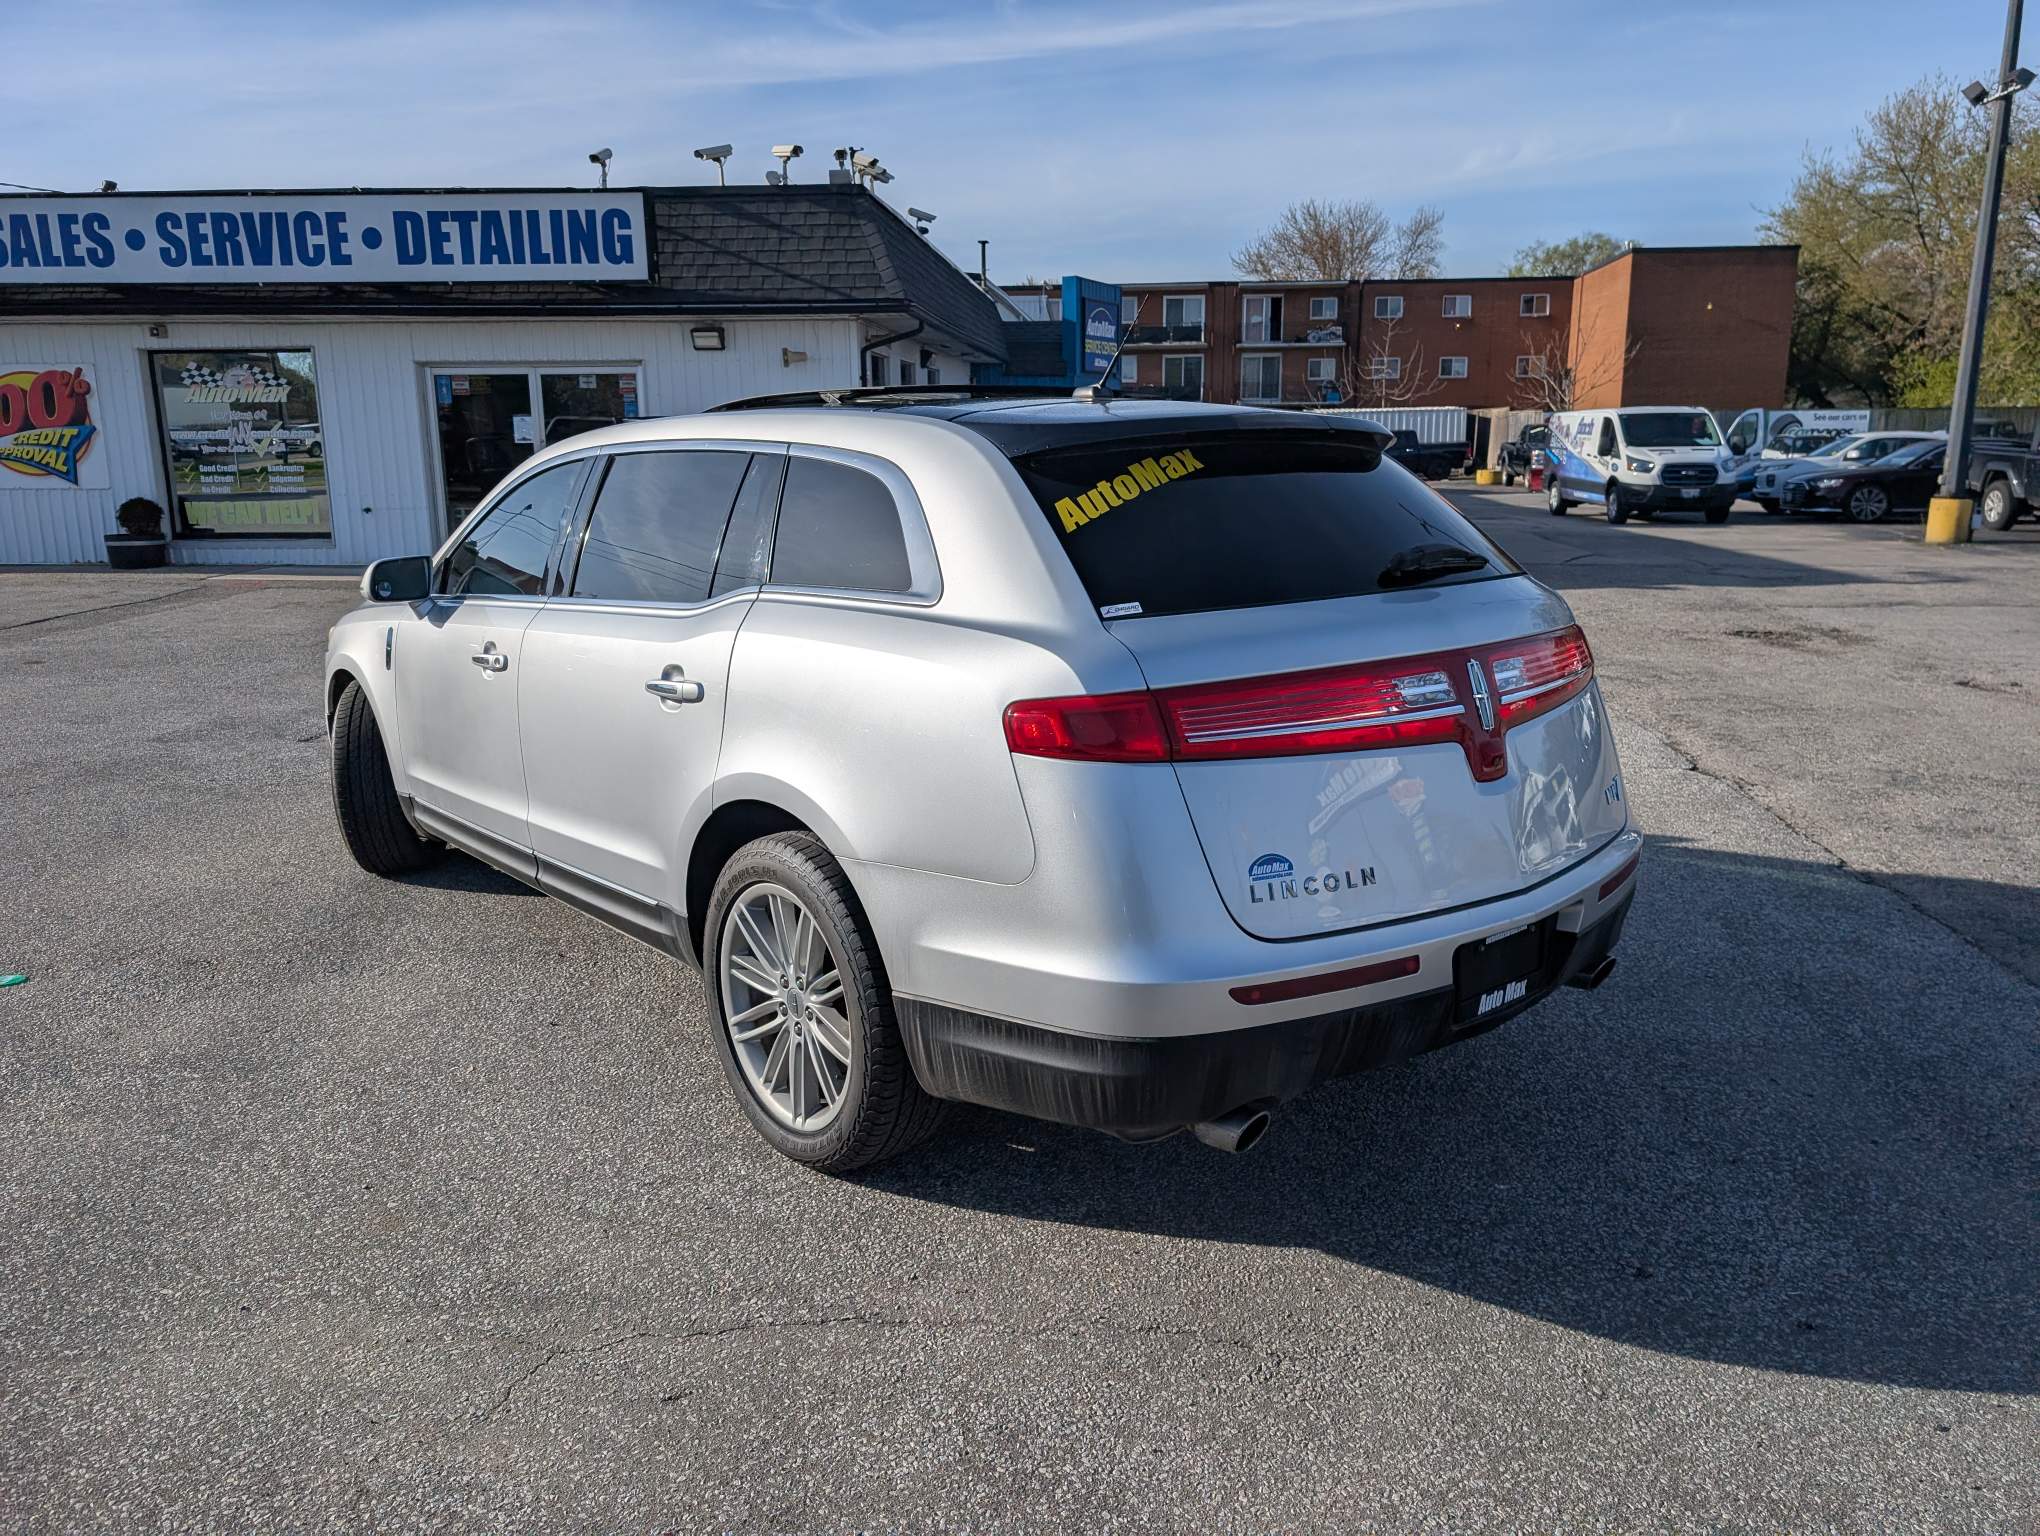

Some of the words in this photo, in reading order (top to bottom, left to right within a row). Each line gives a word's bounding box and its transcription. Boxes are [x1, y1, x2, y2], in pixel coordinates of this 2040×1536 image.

[0, 212, 115, 268] ALES
[155, 210, 352, 268] SERVICE
[392, 208, 634, 265] DETAILING
[1814, 412, 1827, 421] See
[12, 429, 79, 447] CREDIT
[1054, 449, 1205, 534] AutoMax
[1249, 866, 1377, 904] LINCOLN
[1251, 861, 1289, 876] AutoMax
[1477, 989, 1504, 1016] Auto
[1504, 979, 1528, 1003] Max
